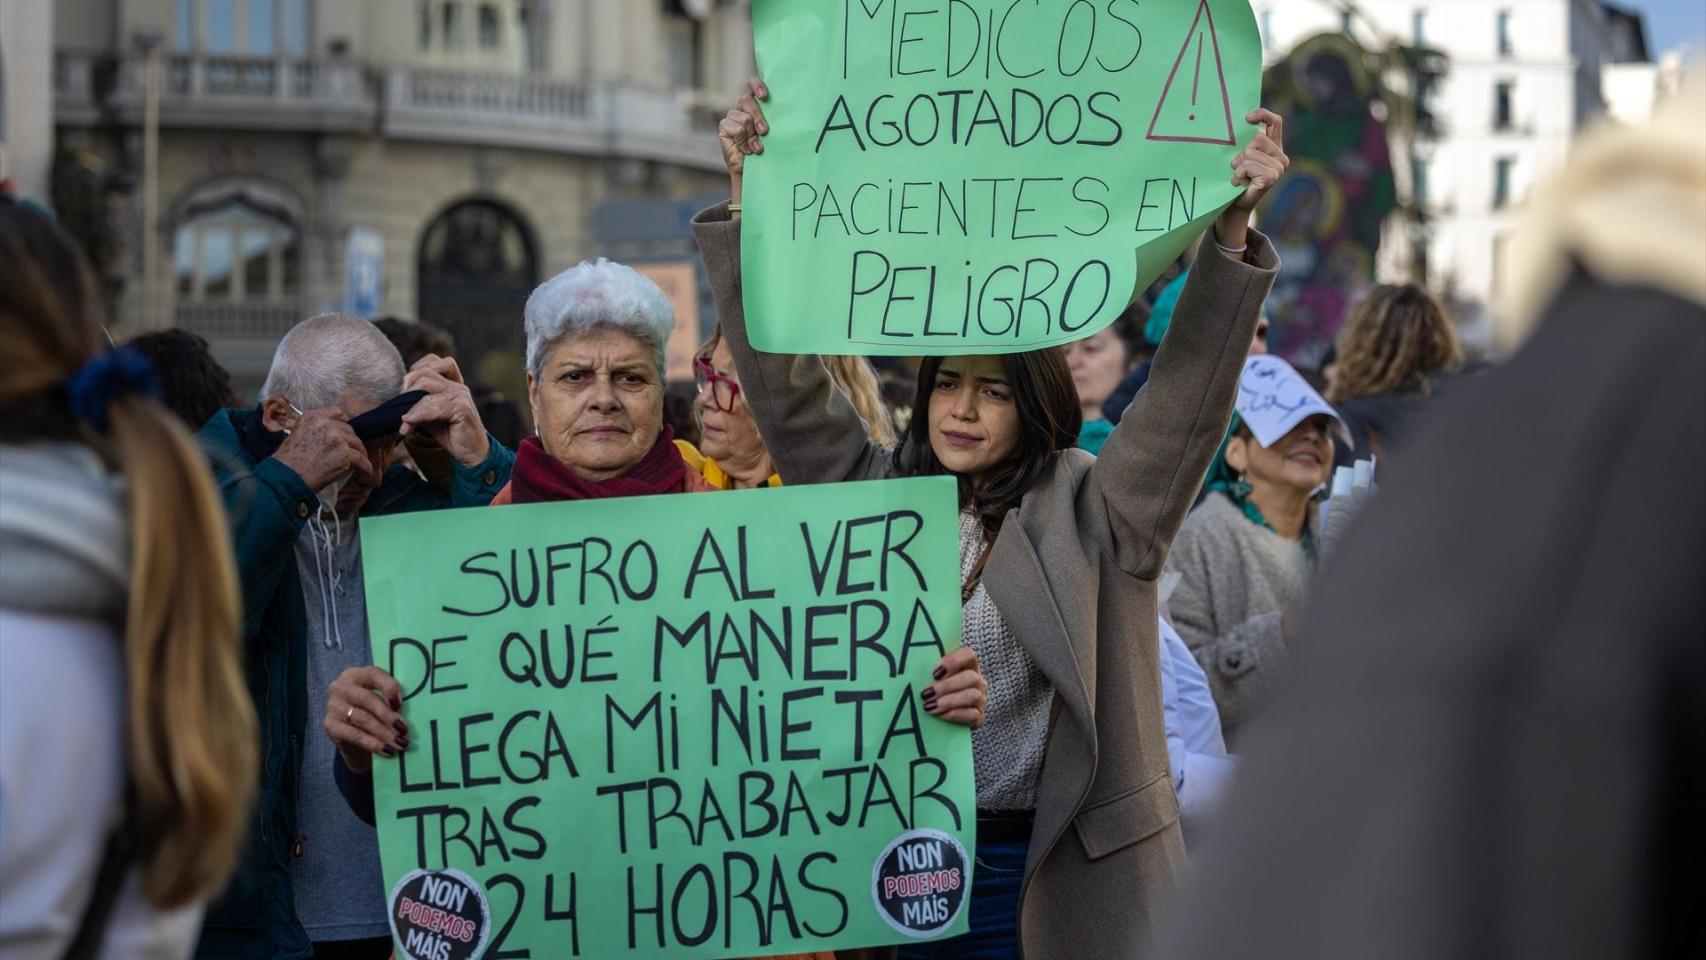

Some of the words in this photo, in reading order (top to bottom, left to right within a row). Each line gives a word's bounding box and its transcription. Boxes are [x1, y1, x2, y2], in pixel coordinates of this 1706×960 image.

[816, 89, 1122, 153] AGOTADOS
[1135, 177, 1197, 232] EN
[442, 537, 659, 616] SUFRO
[684, 526, 775, 602] AL
[800, 510, 928, 597] VER
[389, 635, 468, 701] DE
[499, 615, 619, 688] QUÉ
[653, 598, 945, 684] MANERA
[399, 710, 579, 793] LLEGA
[396, 797, 547, 870] TRAS
[597, 758, 961, 854] TRABAJAR
[884, 868, 960, 899] PODEMOS
[897, 841, 942, 871] NON
[398, 897, 475, 942] PODEMOS
[419, 875, 468, 913] NON
[483, 872, 582, 960] 24
[627, 852, 849, 950] HORAS
